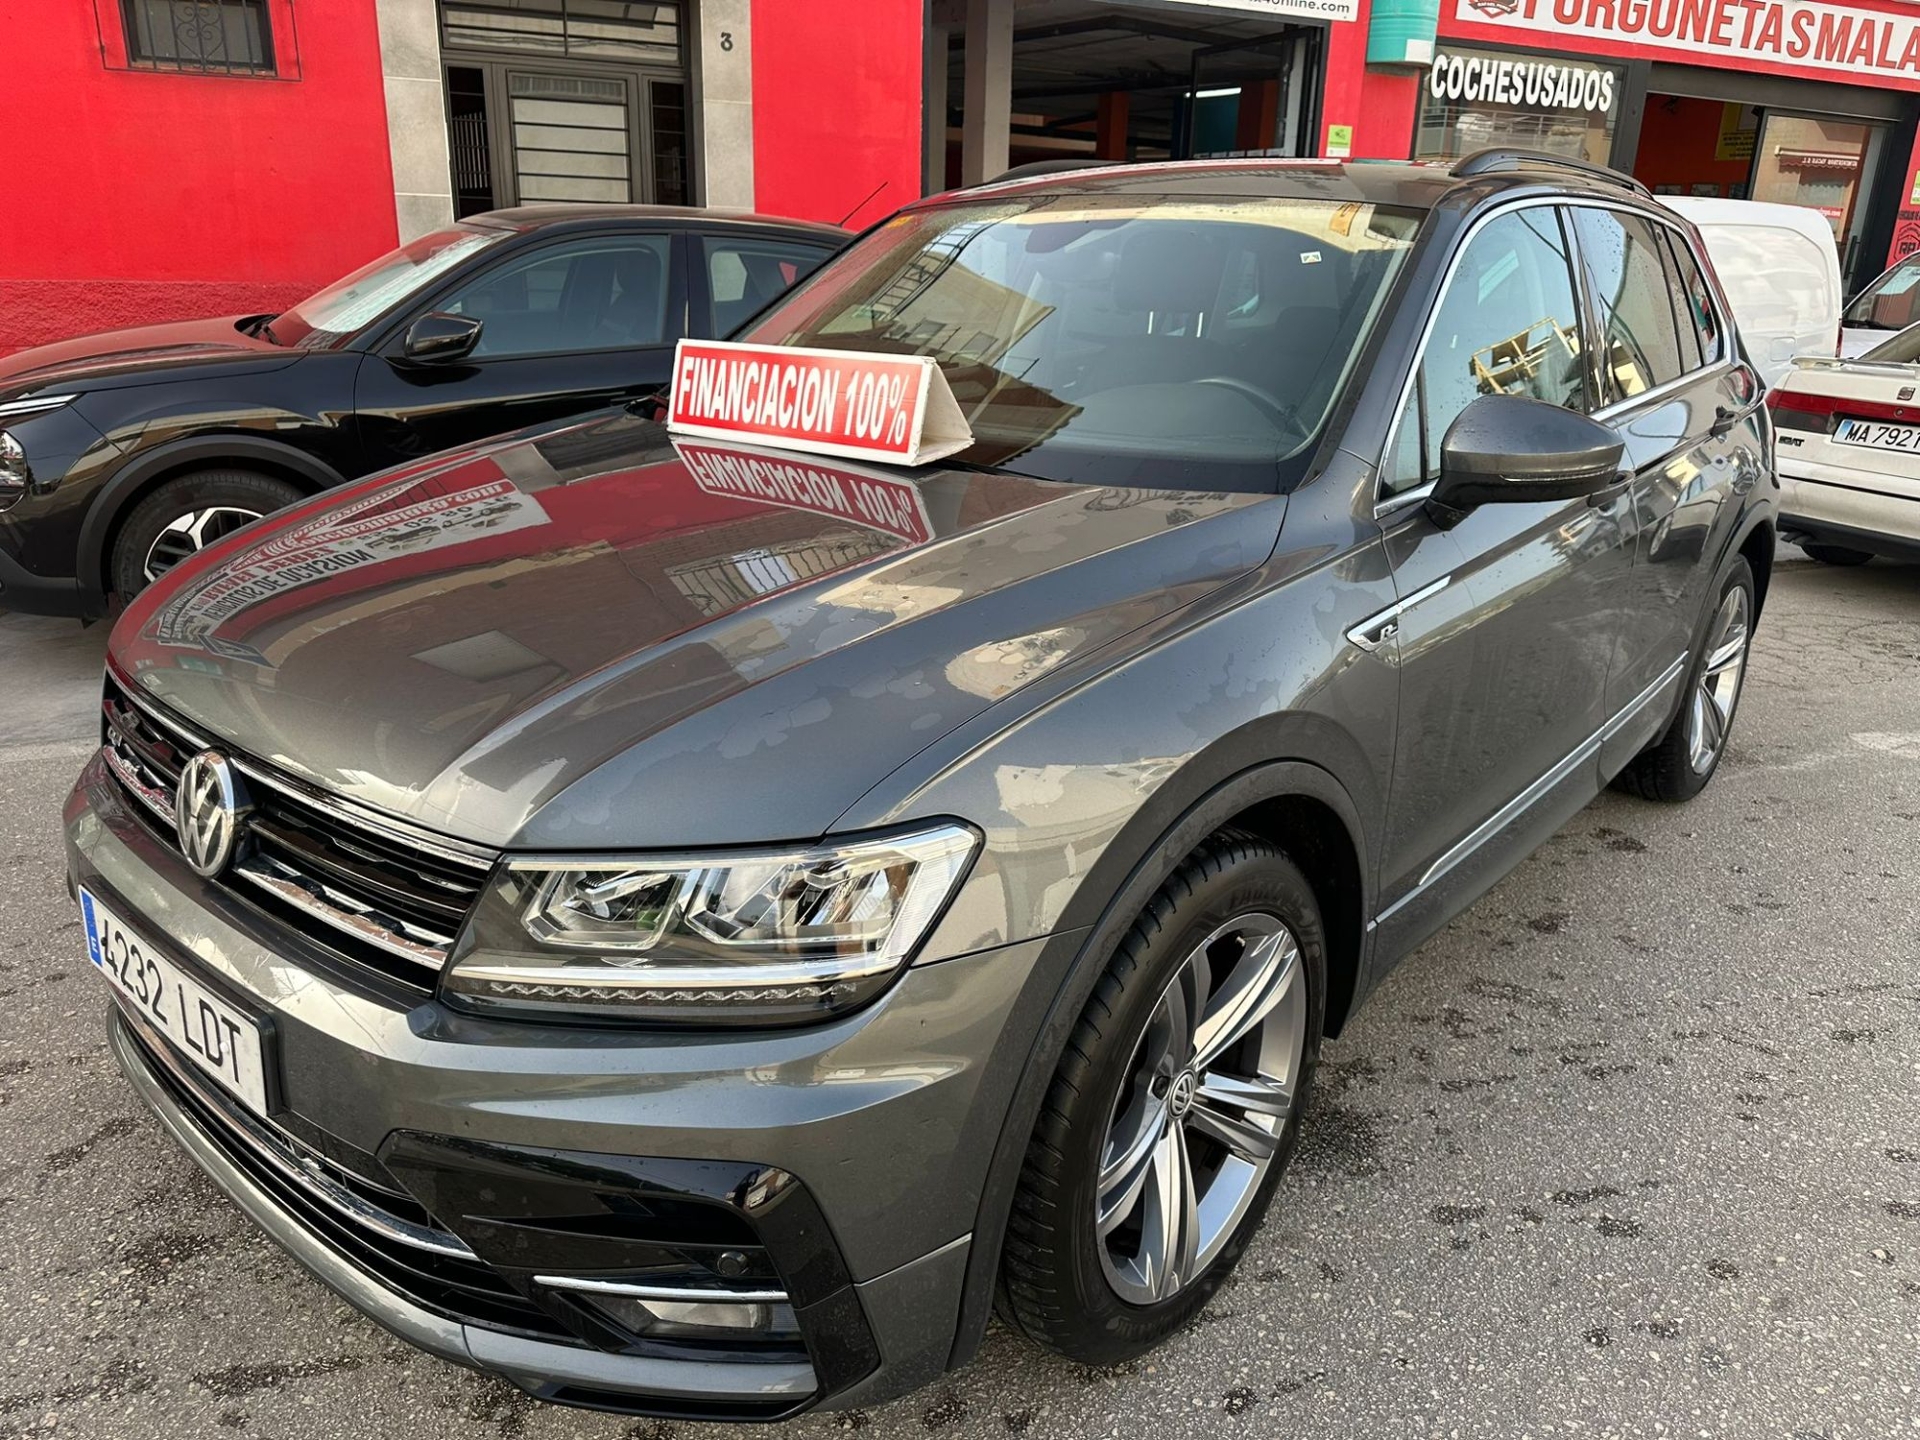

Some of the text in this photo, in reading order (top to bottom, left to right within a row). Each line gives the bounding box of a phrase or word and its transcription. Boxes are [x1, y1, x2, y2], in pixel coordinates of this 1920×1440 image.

[721, 32, 733, 51] 3
[1431, 54, 1614, 112] COCHESUSADOS
[677, 356, 910, 445] FINANCIACION 100%
[1845, 424, 1870, 443] MA
[103, 919, 241, 1084] 4232 LDT
